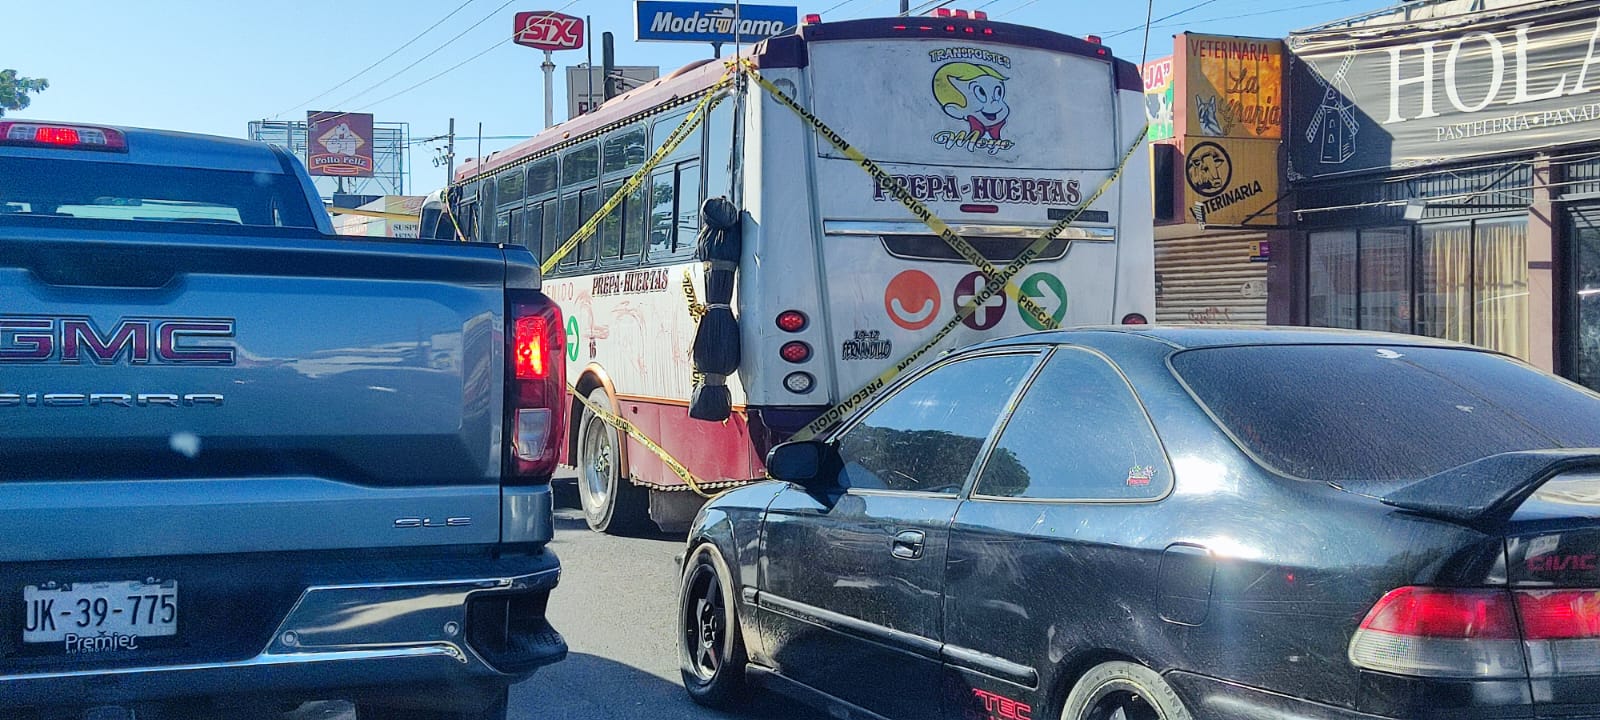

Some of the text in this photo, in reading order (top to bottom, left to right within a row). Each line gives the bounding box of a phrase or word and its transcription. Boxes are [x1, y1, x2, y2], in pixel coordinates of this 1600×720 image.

[929, 47, 1011, 69] TRANSPORTES
[1190, 38, 1270, 62] VETERINARIA
[1226, 67, 1260, 94] La
[1436, 111, 1531, 142] PASTELERÍA
[315, 156, 367, 166] Pollo Feliz
[860, 158, 932, 222] PRECAUCION
[1190, 180, 1264, 221] VTERINARIA
[592, 270, 669, 297] PREPA-HUERTAS
[0, 315, 236, 366] GMC
[808, 377, 884, 435] PRECAUCION
[394, 516, 472, 528] SLE
[24, 594, 176, 632] UK-39-775
[65, 631, 139, 651] Premier
